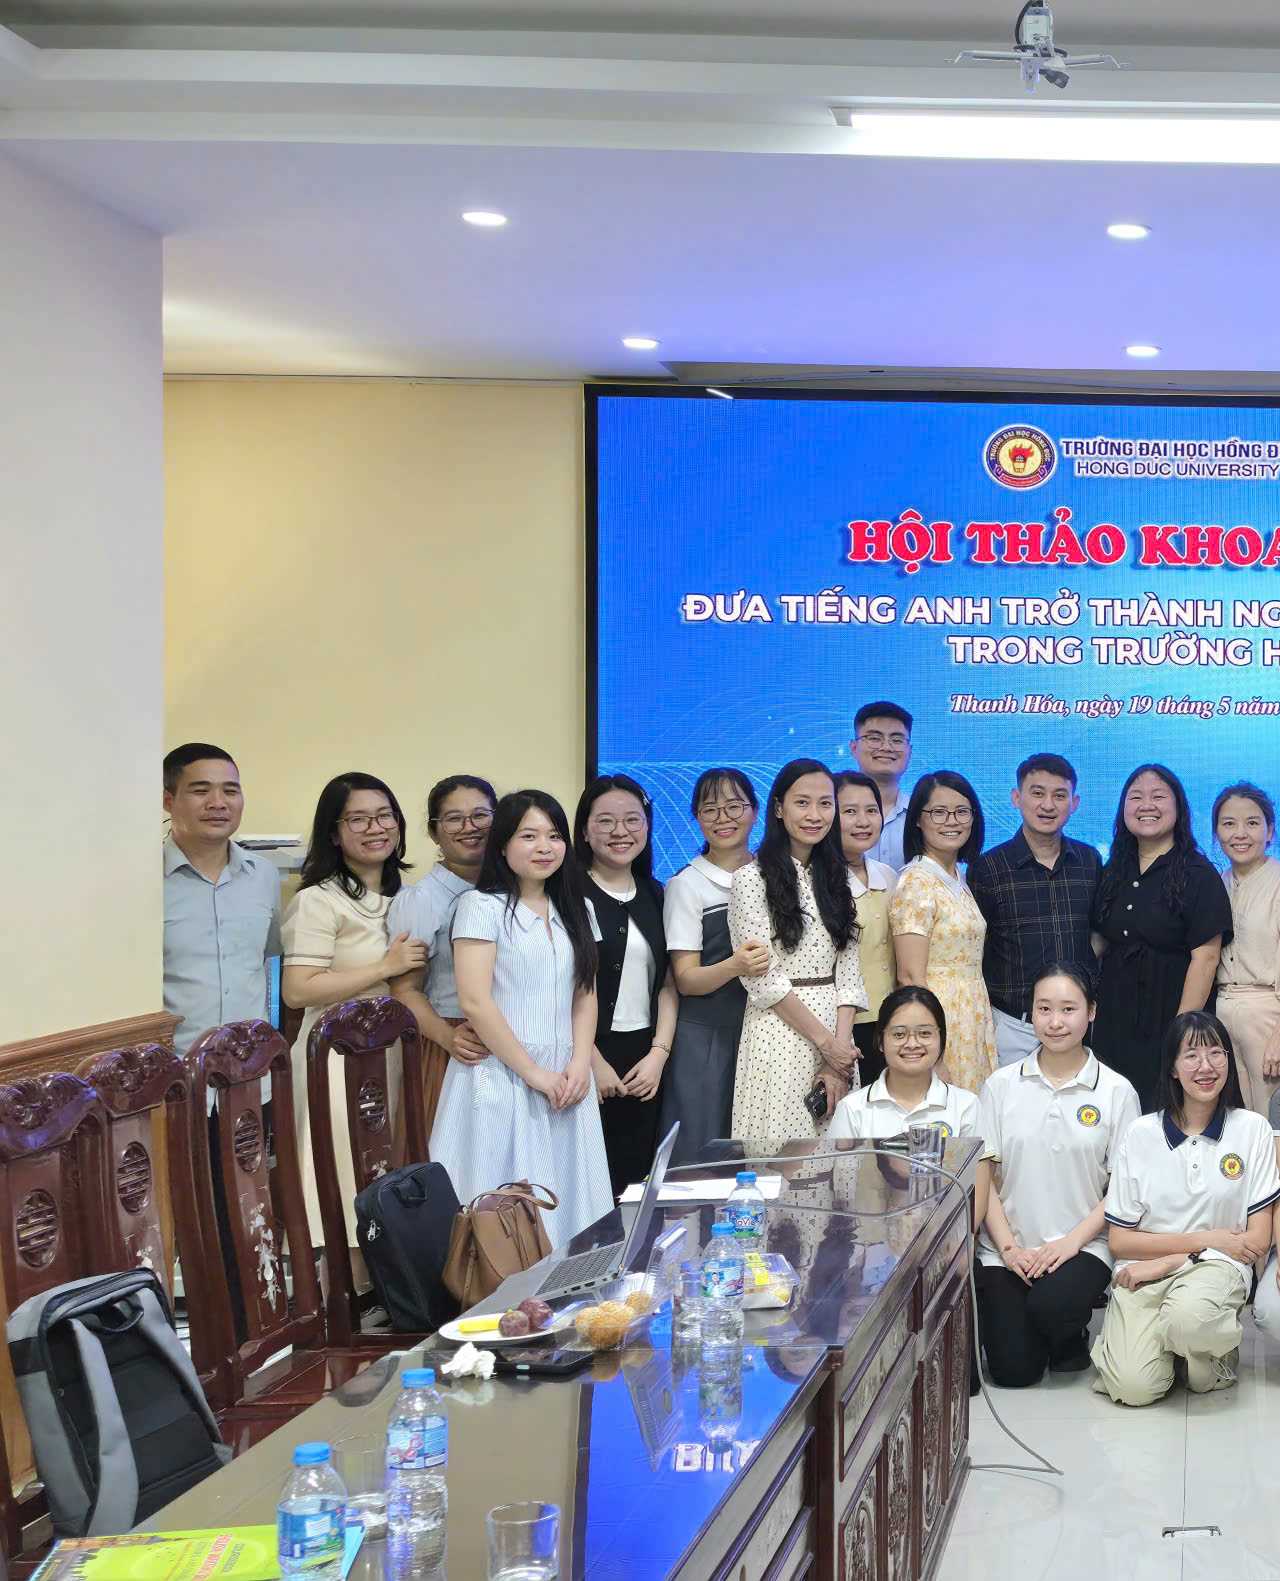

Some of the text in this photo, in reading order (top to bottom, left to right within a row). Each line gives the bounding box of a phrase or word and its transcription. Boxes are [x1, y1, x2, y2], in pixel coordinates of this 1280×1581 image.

[1061, 437, 1133, 456] TRƯỜNG
[1138, 442, 1168, 459] ĐẠI
[1173, 442, 1209, 460] HỌC
[1214, 439, 1262, 458] HỒNG
[1076, 461, 1280, 477] HONG DUC UNIVERSITY
[848, 508, 953, 574] HỘI
[965, 506, 1128, 565] THẢO
[683, 589, 773, 623] ĐƯA
[780, 585, 897, 624] TIẾNG
[904, 596, 992, 625] ANH
[1000, 588, 1081, 626] TRỞ
[1088, 591, 1224, 628] THÀNH
[946, 635, 1084, 666] TRONG
[1090, 630, 1254, 667] TRƯỜNG
[951, 693, 1018, 714] Thanh
[1021, 693, 1071, 717] Hóa,
[1074, 694, 1125, 718] ngày
[1128, 695, 1153, 715] 19
[1156, 695, 1216, 719] tháng
[1217, 696, 1233, 715] 5
